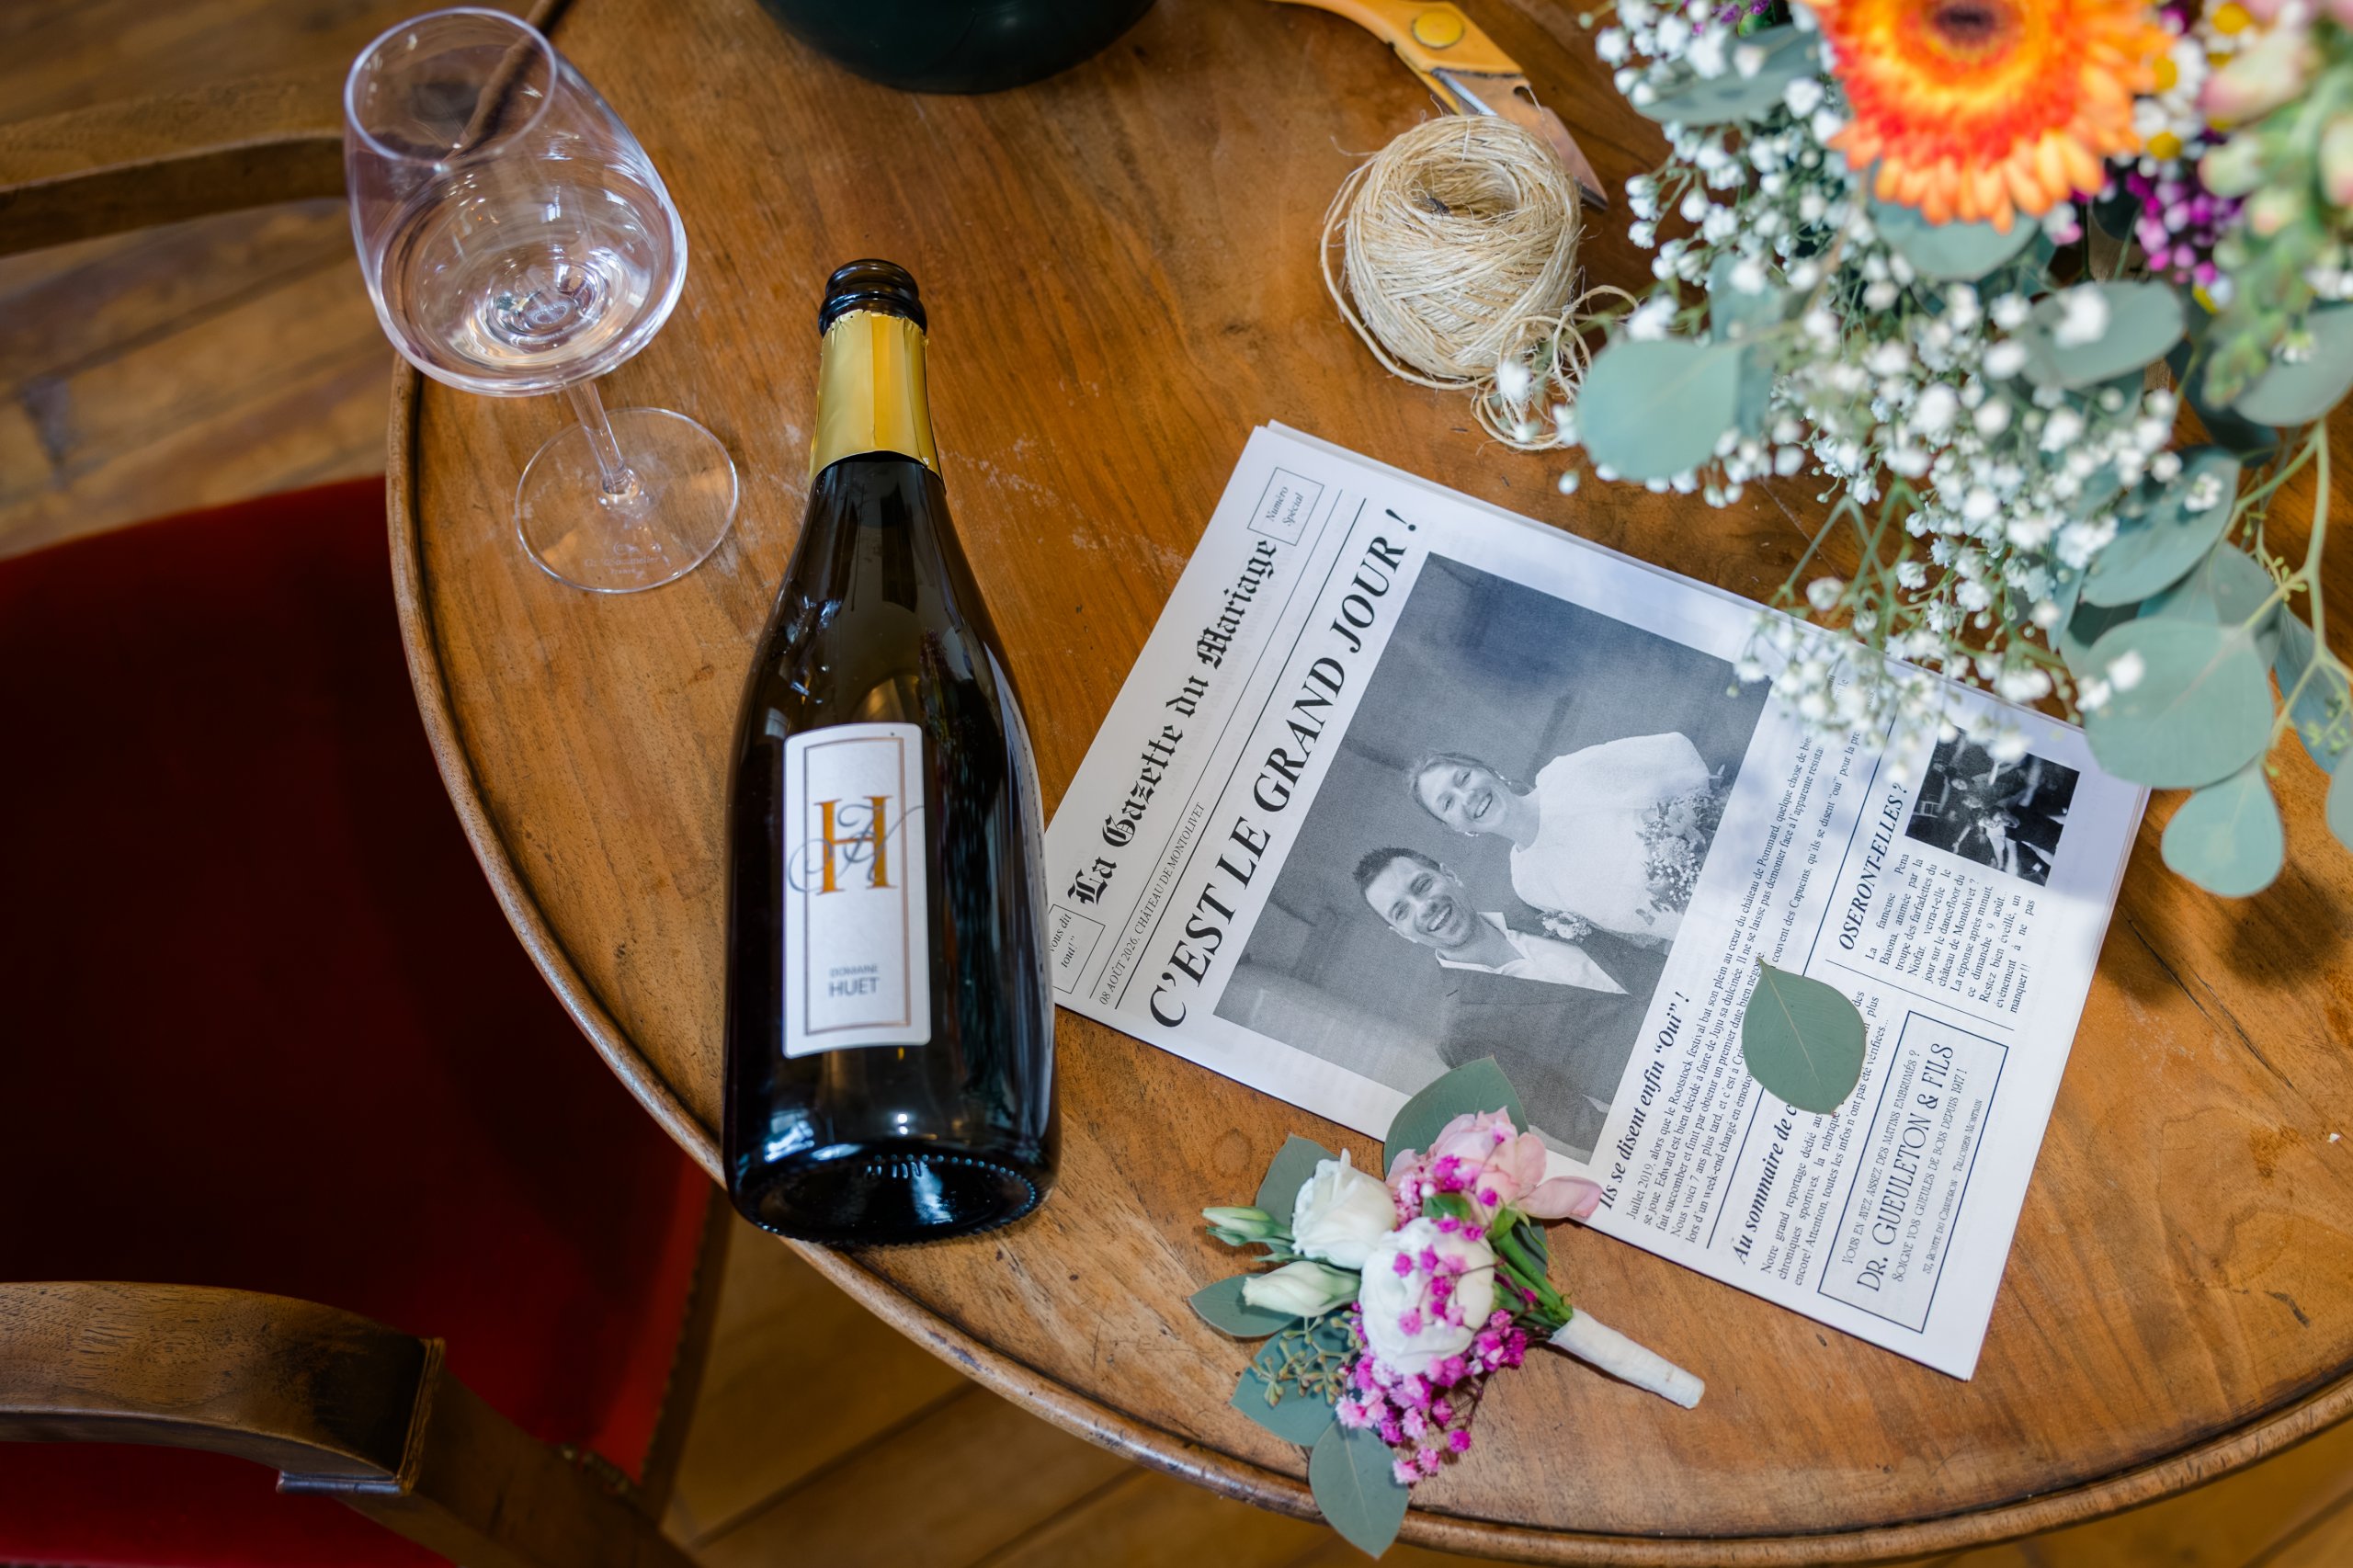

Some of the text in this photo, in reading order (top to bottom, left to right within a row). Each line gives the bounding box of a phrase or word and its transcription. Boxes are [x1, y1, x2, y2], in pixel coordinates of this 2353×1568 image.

[1264, 485, 1289, 522] Numéro
[1281, 491, 1303, 527] Spécial
[1066, 540, 1277, 905] La Gazette du Mariage
[1149, 507, 1416, 1028] C’EST LE GRAND JOUR !
[1786, 763, 1802, 789] chose
[1838, 756, 1851, 777] pour
[1775, 789, 1793, 823] quelque
[1787, 775, 1813, 822] l’apparente
[1818, 801, 1836, 827] disent
[1165, 801, 1204, 869] MONTOLIVET
[1756, 824, 1781, 867] Pommard,
[1778, 829, 1793, 848] face
[1806, 839, 1821, 865] qu’ils
[1838, 781, 1907, 950] OSERONT-ELLES ?
[1158, 866, 1173, 885] DE
[1764, 847, 1786, 889] démonter
[1740, 880, 1759, 914] château
[1759, 889, 1772, 907] pas
[1875, 853, 1909, 929] fameuse Pena
[1894, 892, 1912, 926] animée
[1907, 871, 1918, 889] par
[1058, 913, 1072, 929] dit
[1133, 882, 1164, 935] CHÂTEAU
[1747, 905, 1766, 931] laisse
[1782, 909, 1796, 926] des
[1893, 876, 1933, 971] troupe des farfadettes
[1923, 886, 1946, 934] verra-t-elle
[1727, 927, 1742, 951] cœur
[1771, 926, 1790, 963] couvent
[1921, 886, 1961, 984] jour sur dancefloor
[1937, 886, 1976, 987] château Montolivet
[1955, 942, 1974, 978] réponse
[1968, 916, 1983, 942] après
[1970, 936, 1992, 981] dimanche
[1993, 899, 2035, 1008] événement pas
[828, 963, 879, 978] DOMAINE
[1106, 959, 1126, 993] AOÛT
[1712, 965, 1728, 990] plein
[1977, 971, 1996, 1003] Restez
[1988, 948, 2005, 968] bien
[828, 976, 880, 998] HUET
[1098, 990, 1110, 1005] 08
[1707, 989, 1719, 1007] son
[1735, 987, 1752, 1007] bien
[2009, 972, 2028, 1014] manquer
[1698, 1007, 1712, 1023] bat
[1708, 1018, 1724, 1039] Juju
[1729, 1008, 1744, 1028] date
[1685, 1022, 1706, 1058] festival
[1717, 1028, 1736, 1066] premier
[1695, 1051, 1711, 1074] faire
[1859, 1066, 1872, 1082] été
[1920, 1042, 1953, 1088] FILS
[1667, 1060, 1693, 1105] Rootstock
[1681, 1082, 1700, 1113] décidé
[1699, 1078, 1718, 1112] obtenir
[1721, 1075, 1736, 1098] c’est
[1855, 1080, 1867, 1101] pas
[1949, 1073, 1965, 1094] 1917
[1596, 990, 1689, 1210] Ils se disent enfin “Oui” !
[1845, 1099, 1861, 1126] n’ont
[1915, 1093, 1938, 1109] &
[1939, 1096, 1959, 1130] DEPUIS
[1659, 1117, 1672, 1135] que
[1672, 1114, 1689, 1135] bien
[1694, 1112, 1706, 1131] par
[1759, 1244, 1779, 1274] Notre
[1774, 1210, 1790, 1242] grand
[1785, 1162, 1807, 1208] reportage
[1799, 1131, 1816, 1159] dédié
[1849, 990, 1865, 1007] des
[1777, 1225, 1802, 1279] chroniques
[1821, 1108, 1841, 1152] rubrique
[1865, 995, 1880, 1017] plus
[1648, 1136, 1665, 1160] alors
[1670, 1135, 1682, 1151] est
[1684, 1130, 1700, 1151] finit
[1700, 1134, 1715, 1157] plus
[1837, 1126, 1852, 1152] infos
[1931, 1130, 1948, 1155] BOIS
[1653, 1149, 1676, 1187] Edward
[1695, 1156, 1707, 1174] ans
[1829, 1152, 1844, 1167] les
[1840, 1049, 1920, 1264] VOUS EN AVEZ ASSEZ DES MATINS EMBRUMÉS ?
[1927, 1155, 1940, 1171] DE
[1664, 1161, 1688, 1213] succomber
[1684, 1120, 1737, 1244] lors d’un week-end chargé
[1732, 1233, 1753, 1265] Au
[1745, 1142, 1784, 1233] sommaire
[1773, 1118, 1792, 1141] de
[1821, 1167, 1838, 1198] toutes
[1871, 1111, 1931, 1245] GUEULETON
[1625, 1189, 1645, 1220] Juillet
[1682, 1183, 1697, 1208] voici
[1914, 1172, 1935, 1216] GUEULES
[1654, 1213, 1670, 1232] fait
[1669, 1210, 1688, 1237] Nous
[1804, 1200, 1829, 1248] Attention,
[1905, 1218, 1921, 1239] VOS
[1935, 1221, 1945, 1234] DU
[1891, 1241, 1914, 1282] SOIGNE
